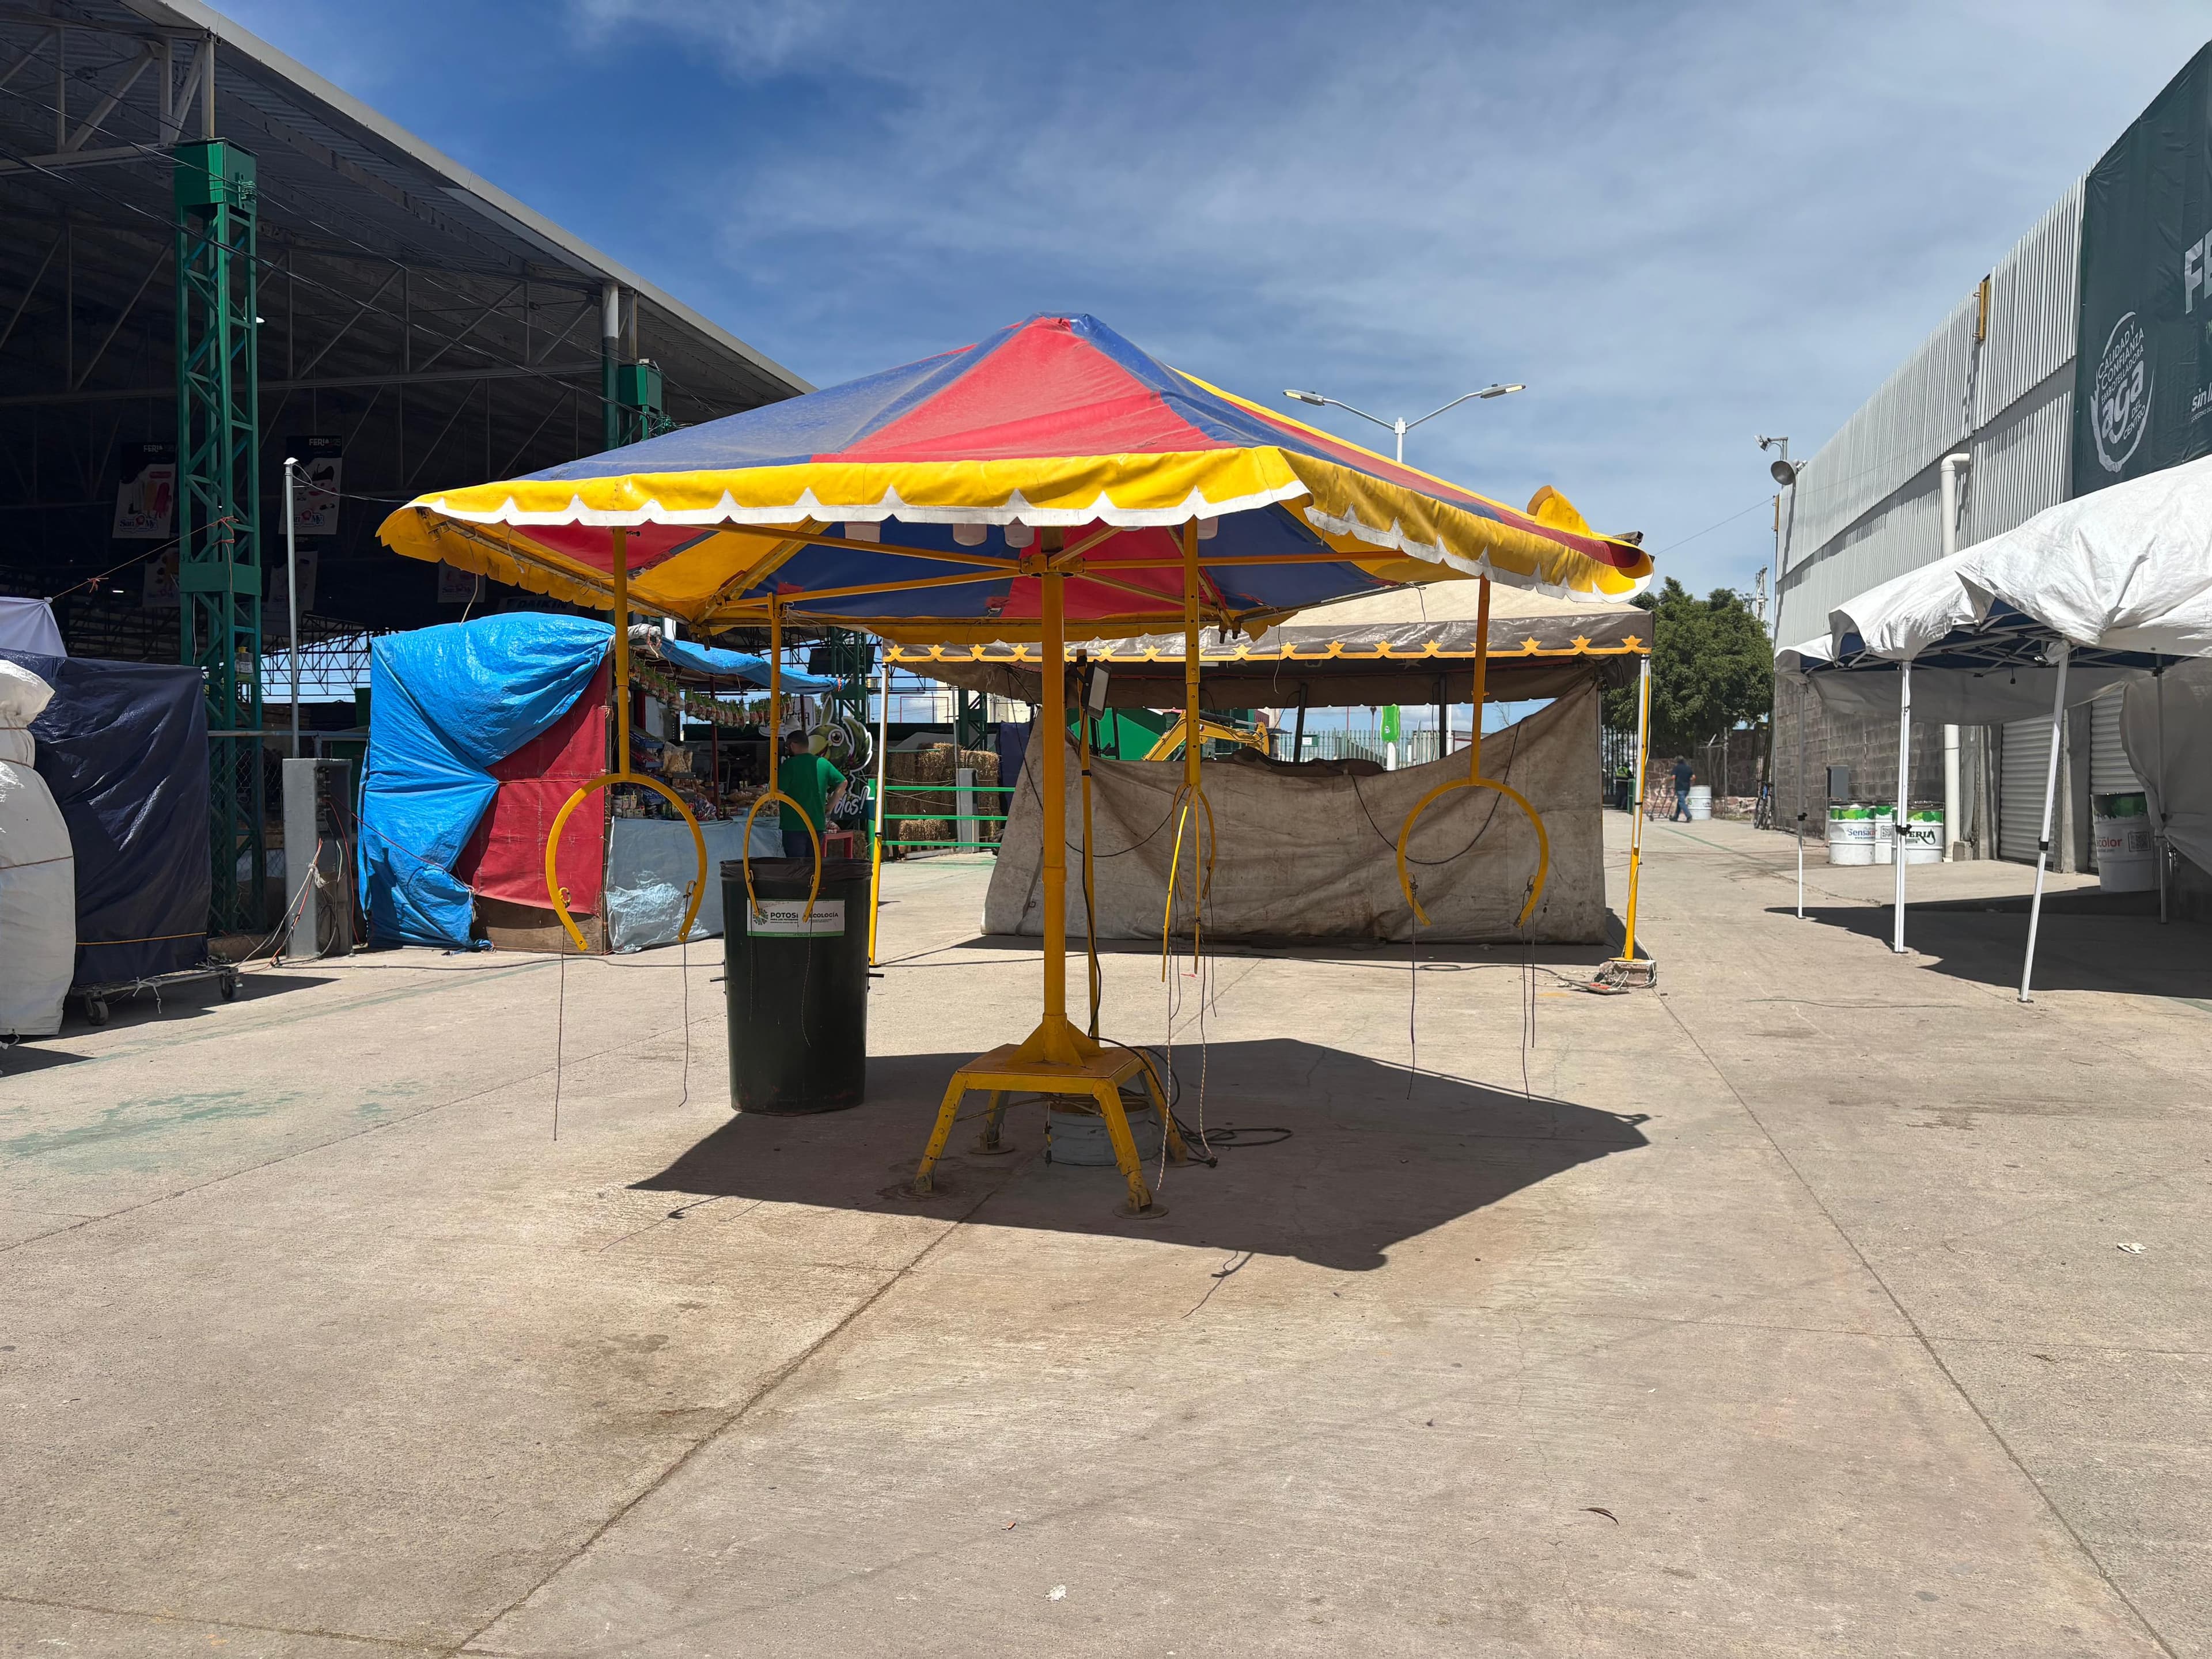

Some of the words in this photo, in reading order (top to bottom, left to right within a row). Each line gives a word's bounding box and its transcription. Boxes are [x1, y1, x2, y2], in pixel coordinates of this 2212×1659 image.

[2099, 331, 2130, 379] CALIDAD
[2131, 321, 2134, 335] Y
[2102, 328, 2144, 390] CONFIANZA
[2102, 345, 2143, 405] EMBOTELLADORA
[2103, 360, 2144, 444] aga
[2123, 405, 2145, 440] CENTRO
[2132, 399, 2141, 419] DEL
[2191, 388, 2207, 412] sin
